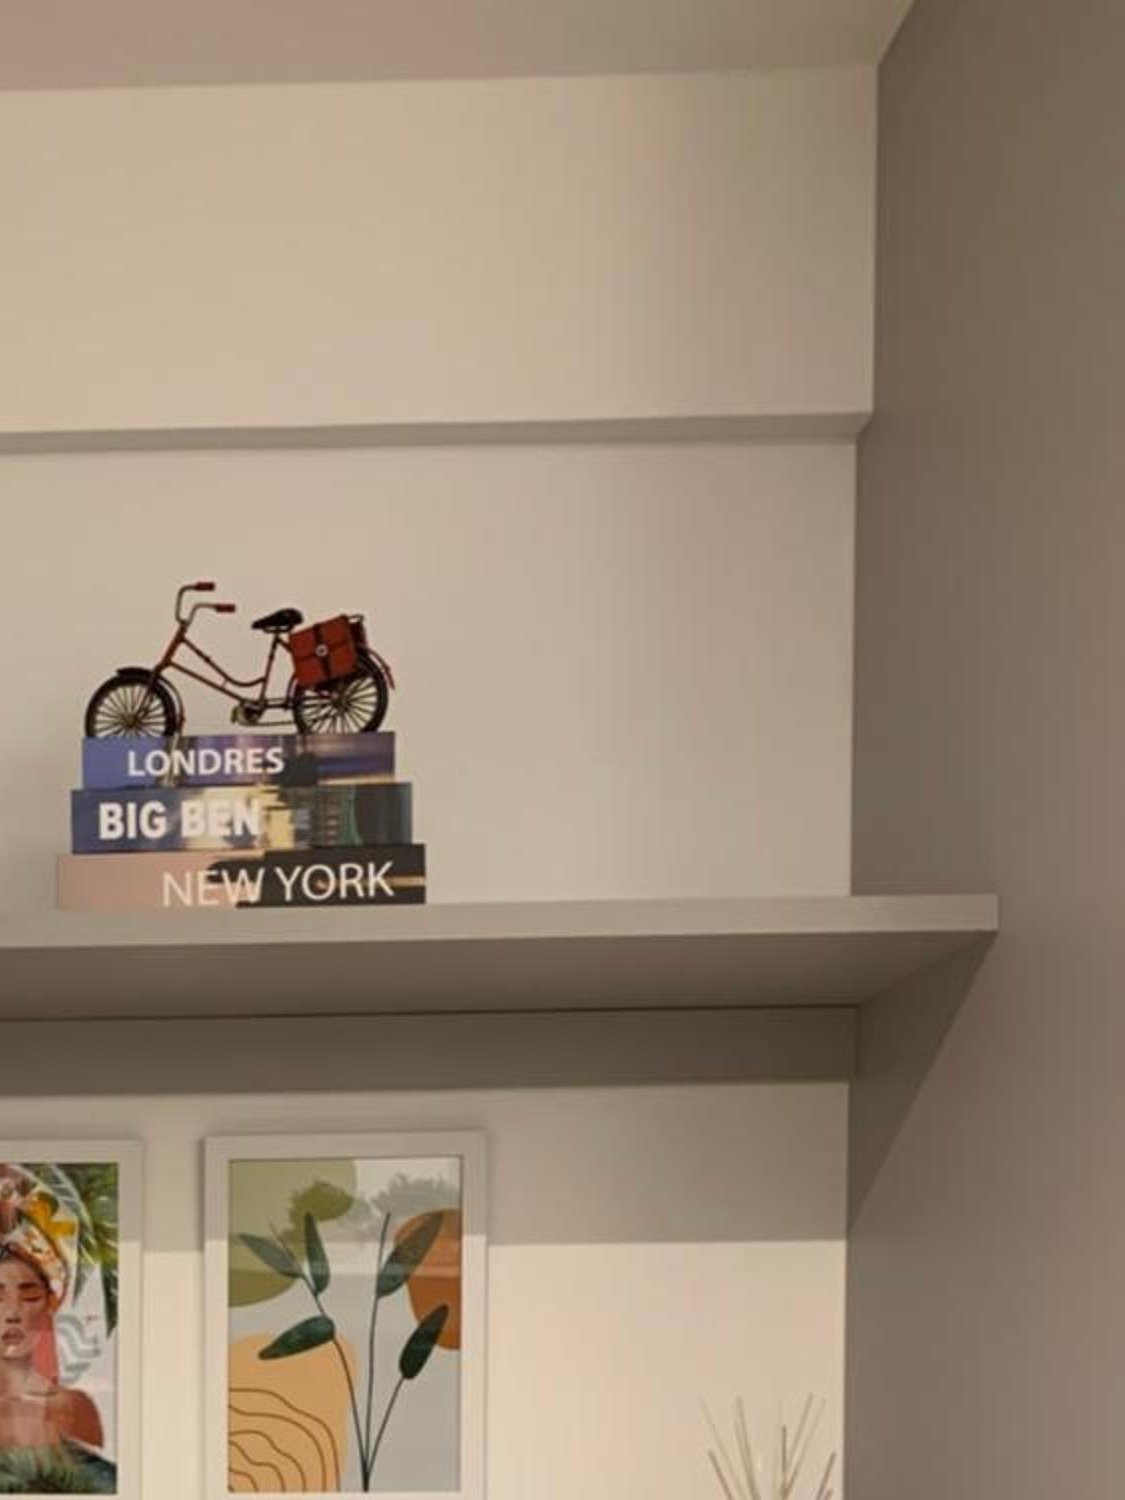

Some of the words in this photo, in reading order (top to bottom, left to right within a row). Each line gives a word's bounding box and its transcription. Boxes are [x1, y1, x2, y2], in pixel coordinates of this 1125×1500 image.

[126, 746, 285, 777] LONDRES
[97, 801, 168, 841] BIG
[180, 798, 261, 838] BEN
[161, 866, 266, 908] NEW
[275, 860, 395, 902] YORK
